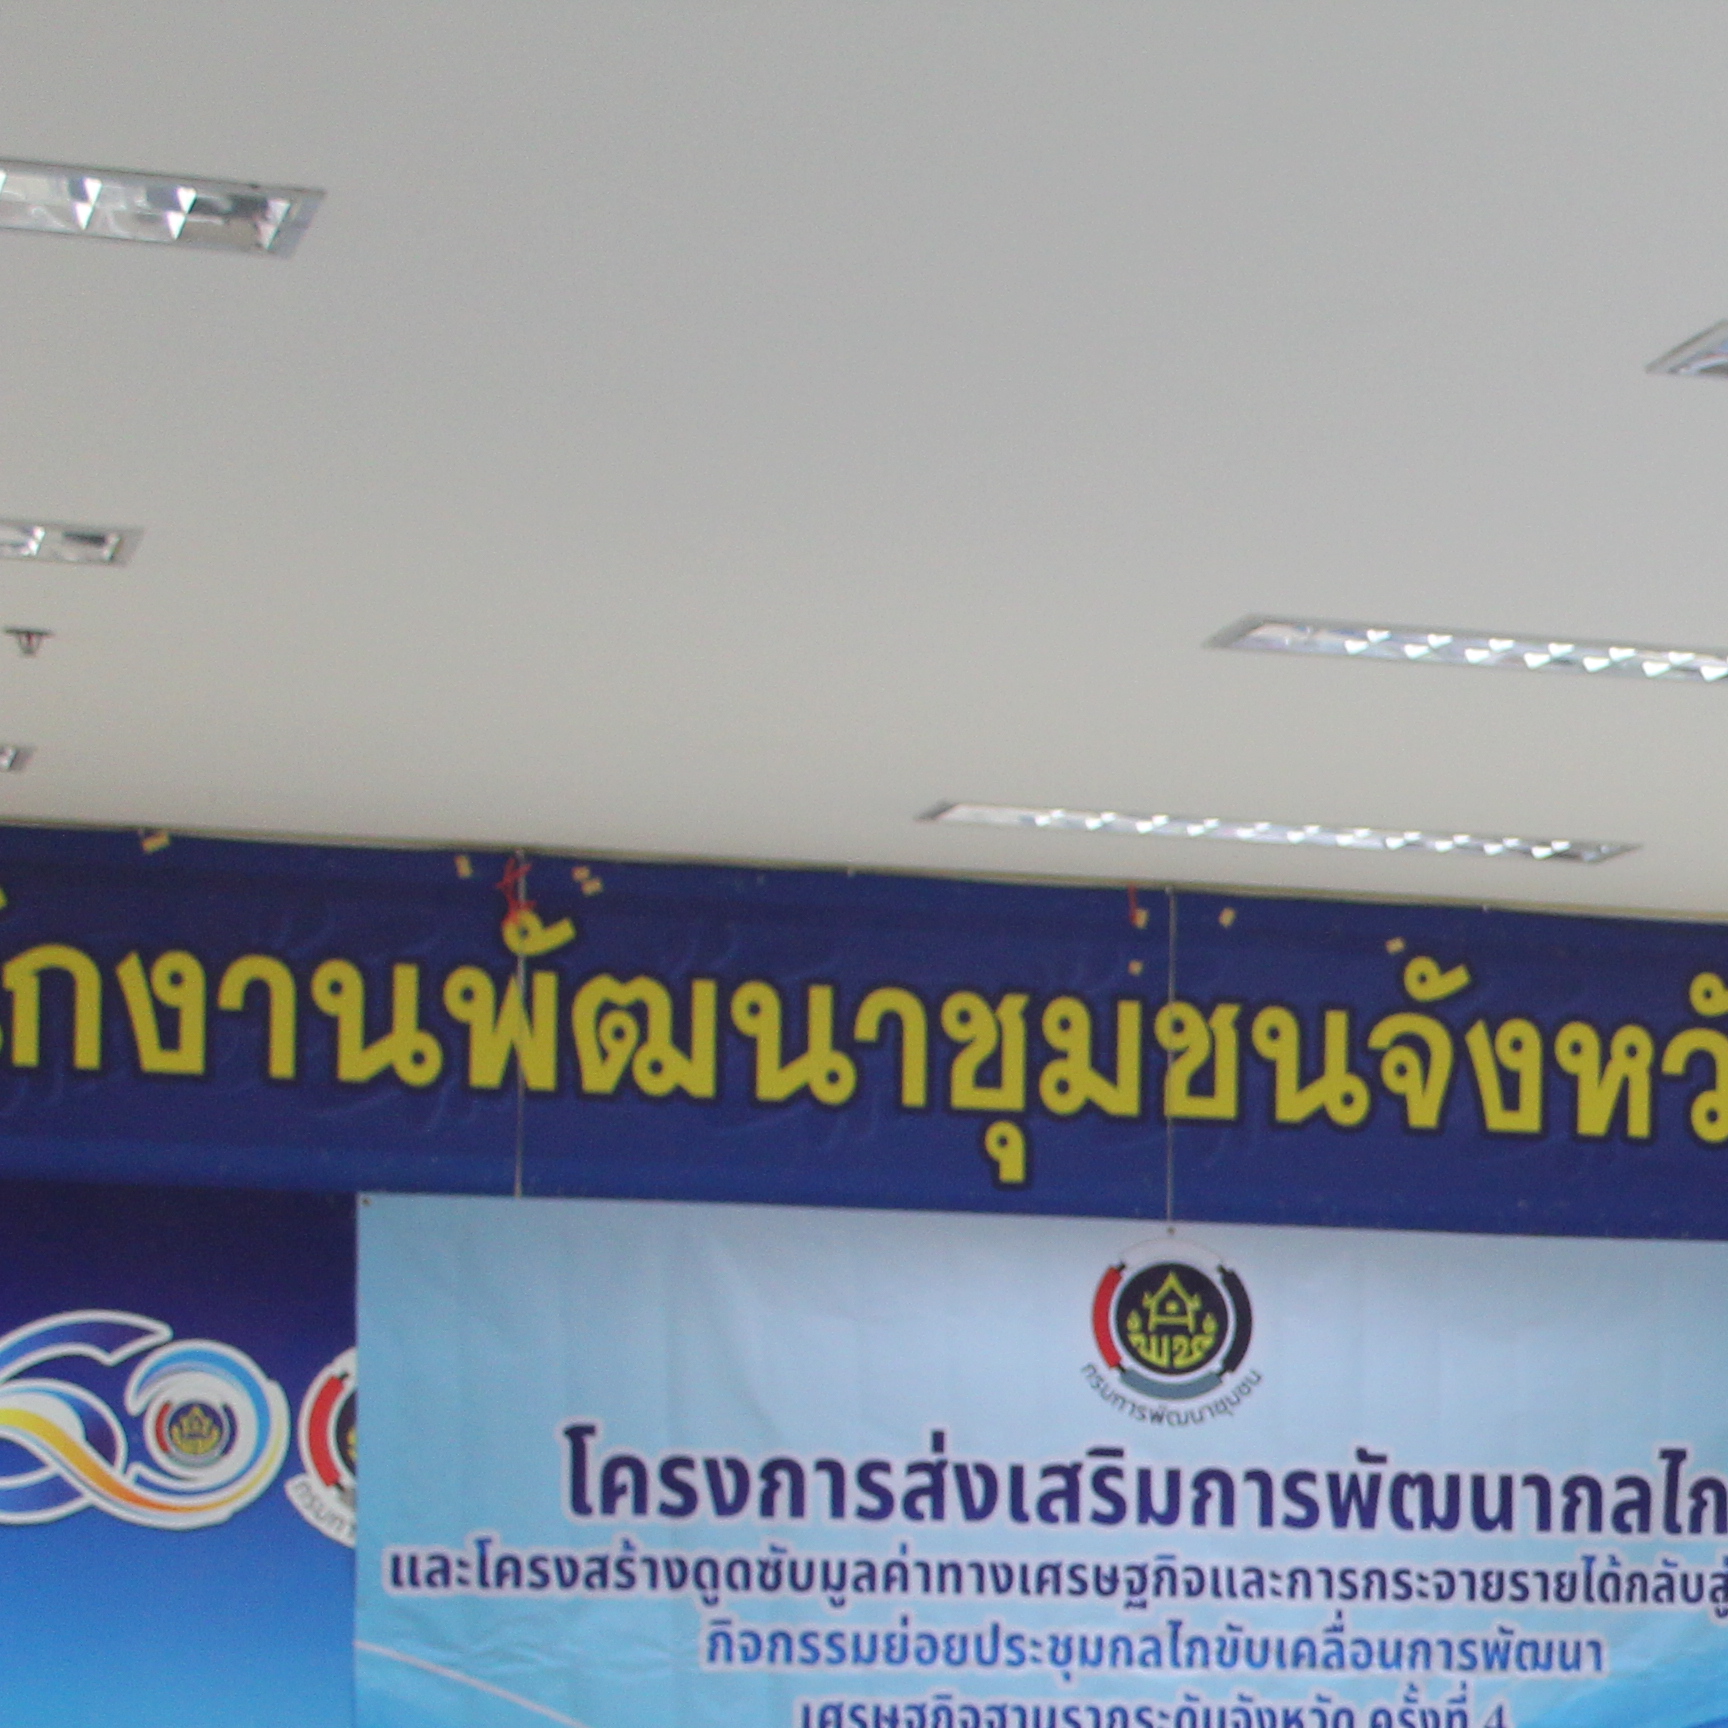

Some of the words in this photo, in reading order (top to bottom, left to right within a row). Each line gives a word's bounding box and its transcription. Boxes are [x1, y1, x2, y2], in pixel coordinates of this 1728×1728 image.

[1081, 1362, 1263, 1428] กรมการพัฒนาชุมชน
[705, 1610, 1604, 1680] กิจกรรมย่อยประชุมกลไกขับเคลื่อนการพัฒนา
